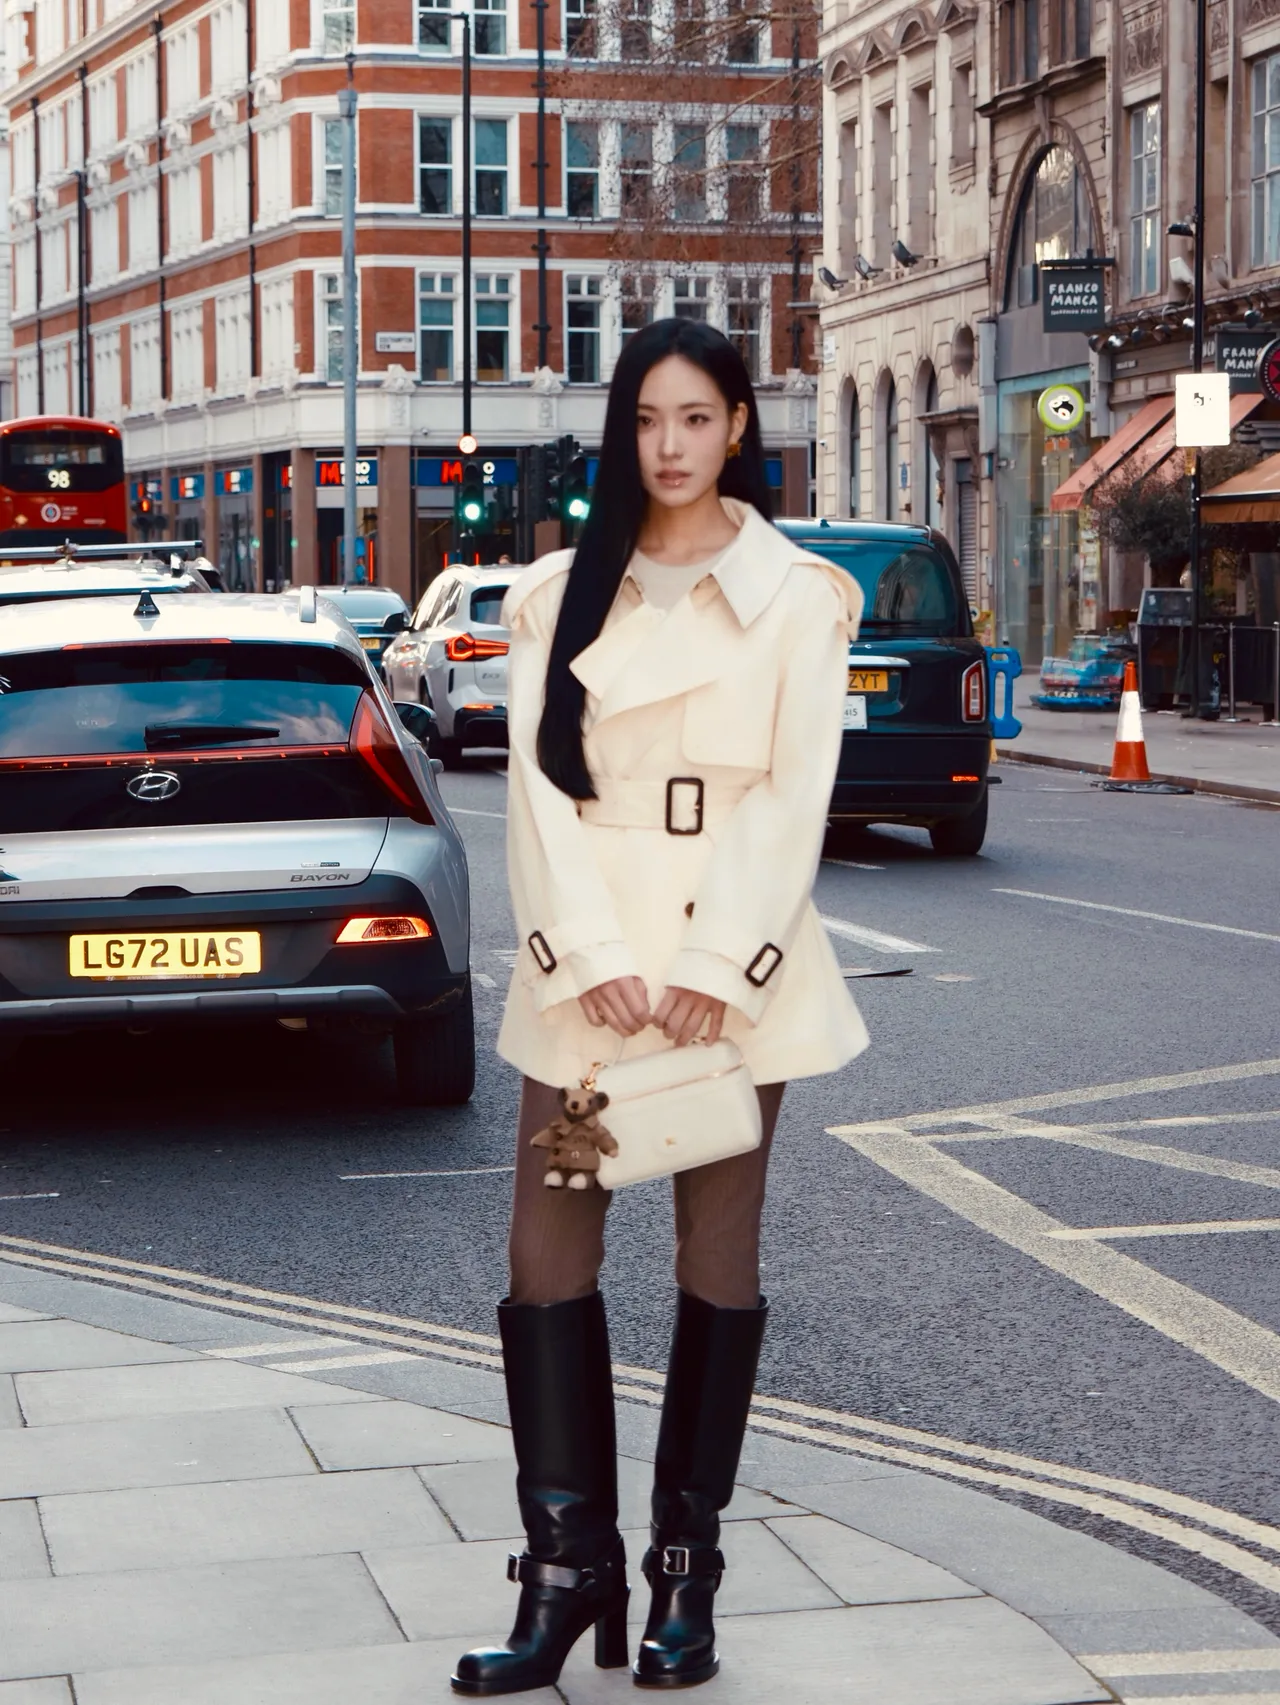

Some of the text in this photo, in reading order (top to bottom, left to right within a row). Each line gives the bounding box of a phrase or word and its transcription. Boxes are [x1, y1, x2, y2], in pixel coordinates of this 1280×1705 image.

[1049, 283, 1099, 294] FRANCO
[1051, 294, 1098, 306] MANCA
[48, 470, 70, 488] 98
[848, 673, 880, 688] ZYT
[290, 873, 350, 882] BAYON
[83, 937, 244, 969] LG72 UAS
